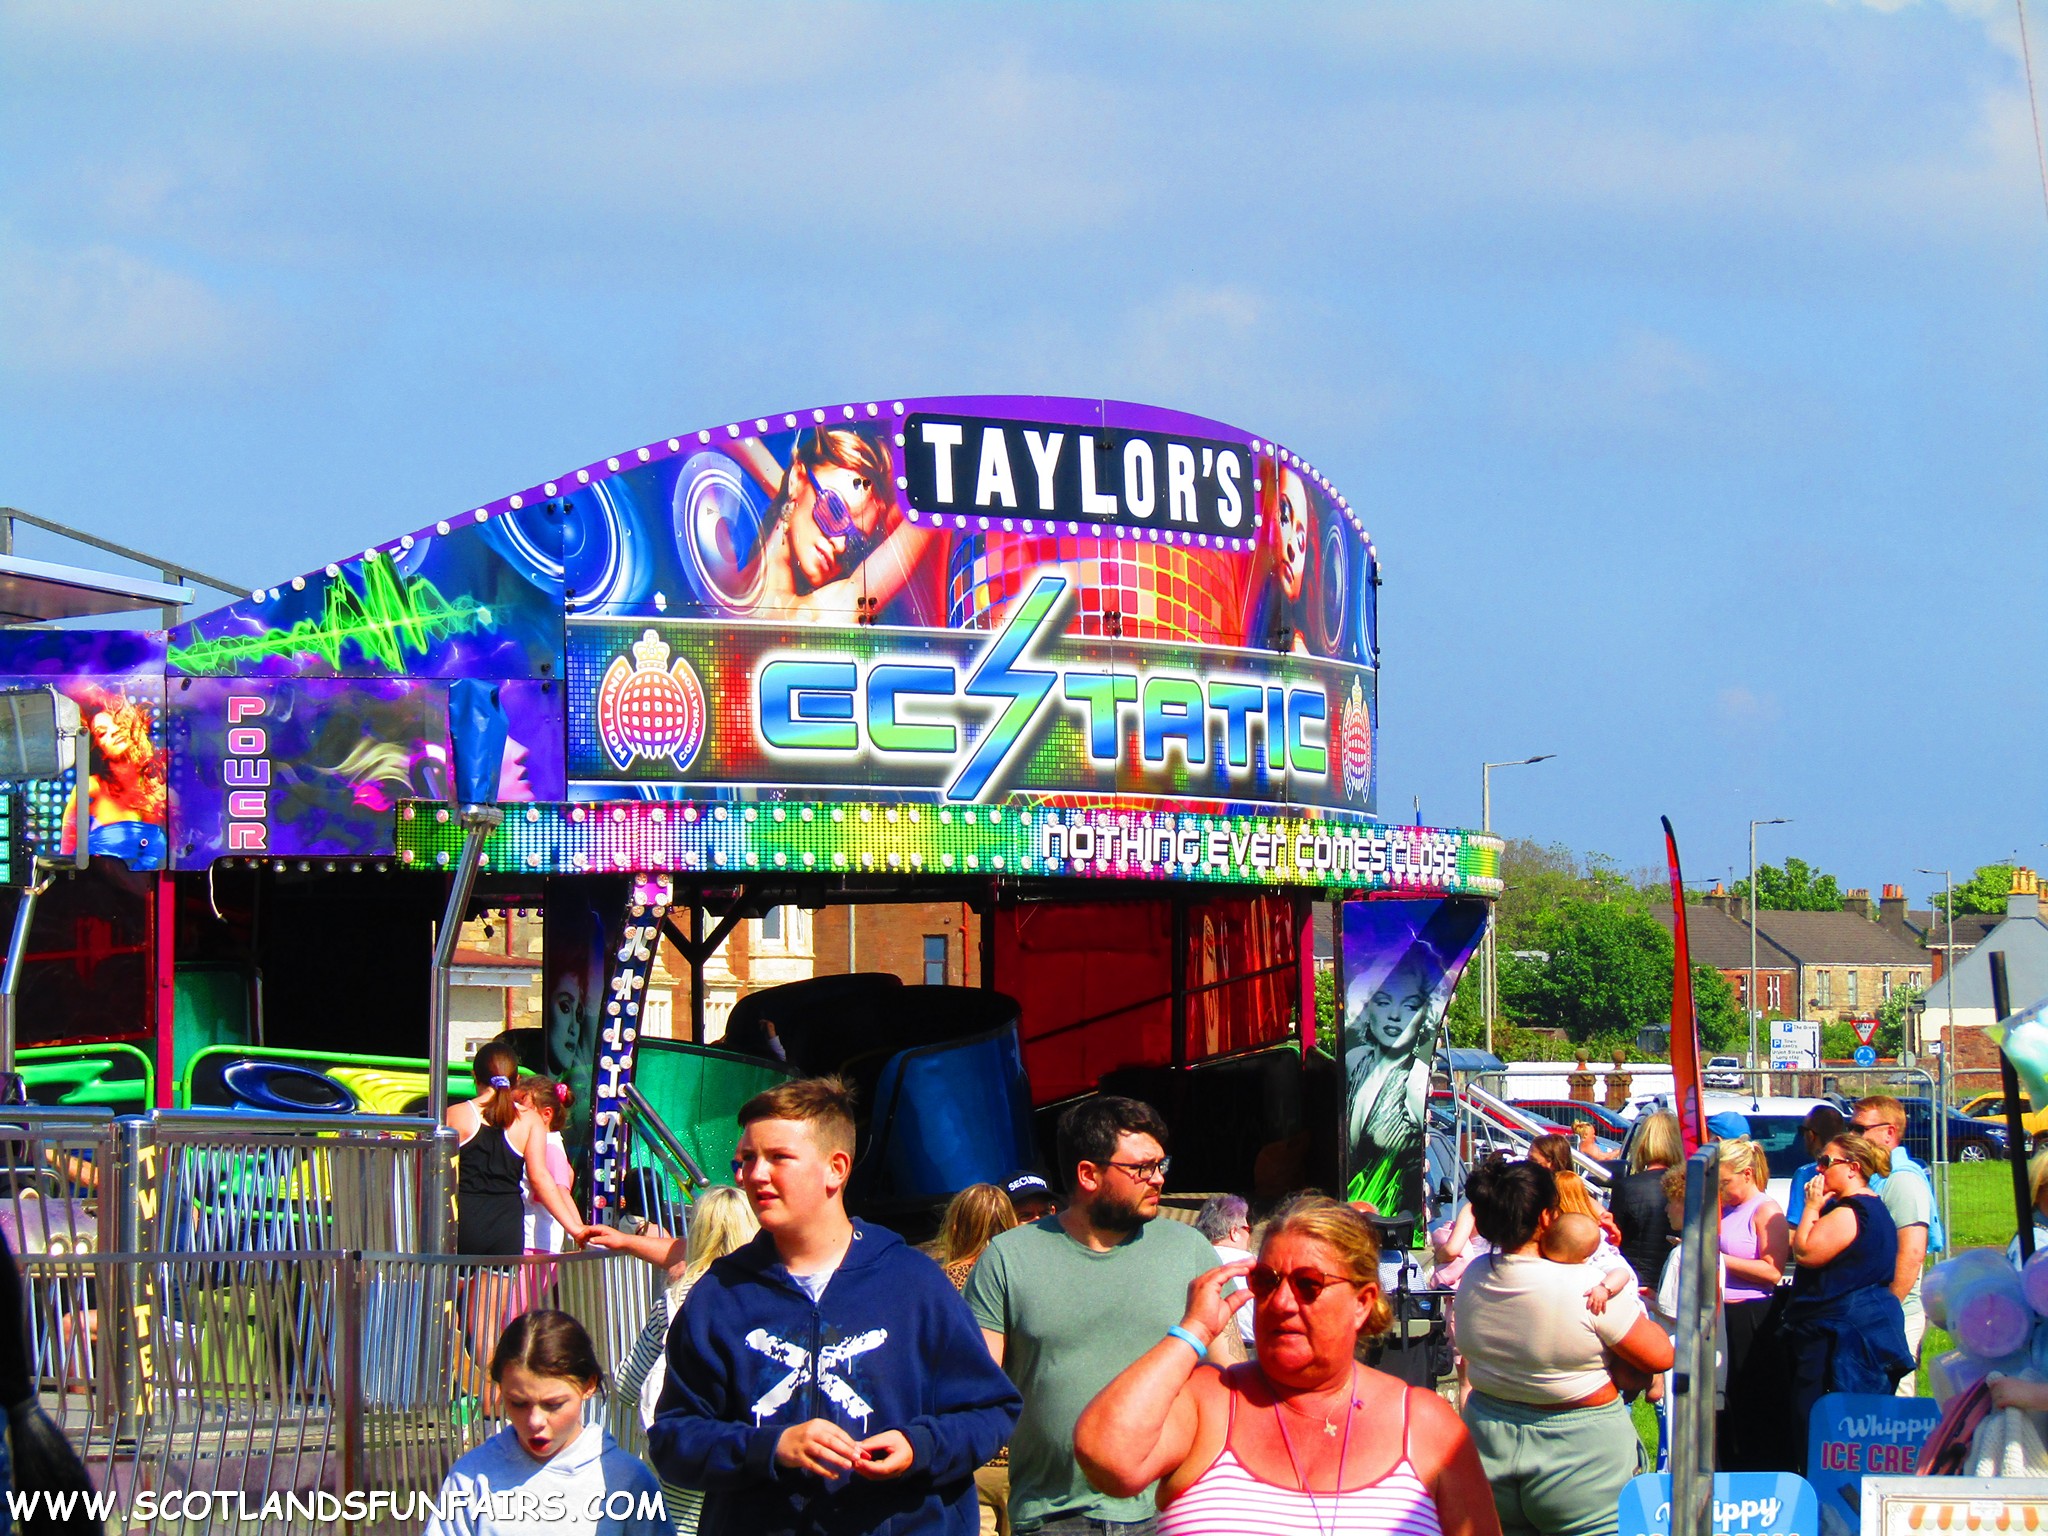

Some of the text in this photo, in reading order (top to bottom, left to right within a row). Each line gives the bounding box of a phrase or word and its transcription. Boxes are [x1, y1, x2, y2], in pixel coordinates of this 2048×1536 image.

[921, 422, 1243, 529] TAYLOR'S
[604, 665, 628, 761] HOLLAND
[678, 668, 700, 762] CORPORATION
[759, 576, 1328, 801] ECSTATIC
[223, 696, 271, 850] POWER
[1042, 823, 1200, 864] NOTHING
[1294, 834, 1388, 872] COMES
[1391, 840, 1457, 876] CLOSE
[1821, 1441, 1924, 1474] ICE CRE
[1838, 1414, 1937, 1444] Whippy
